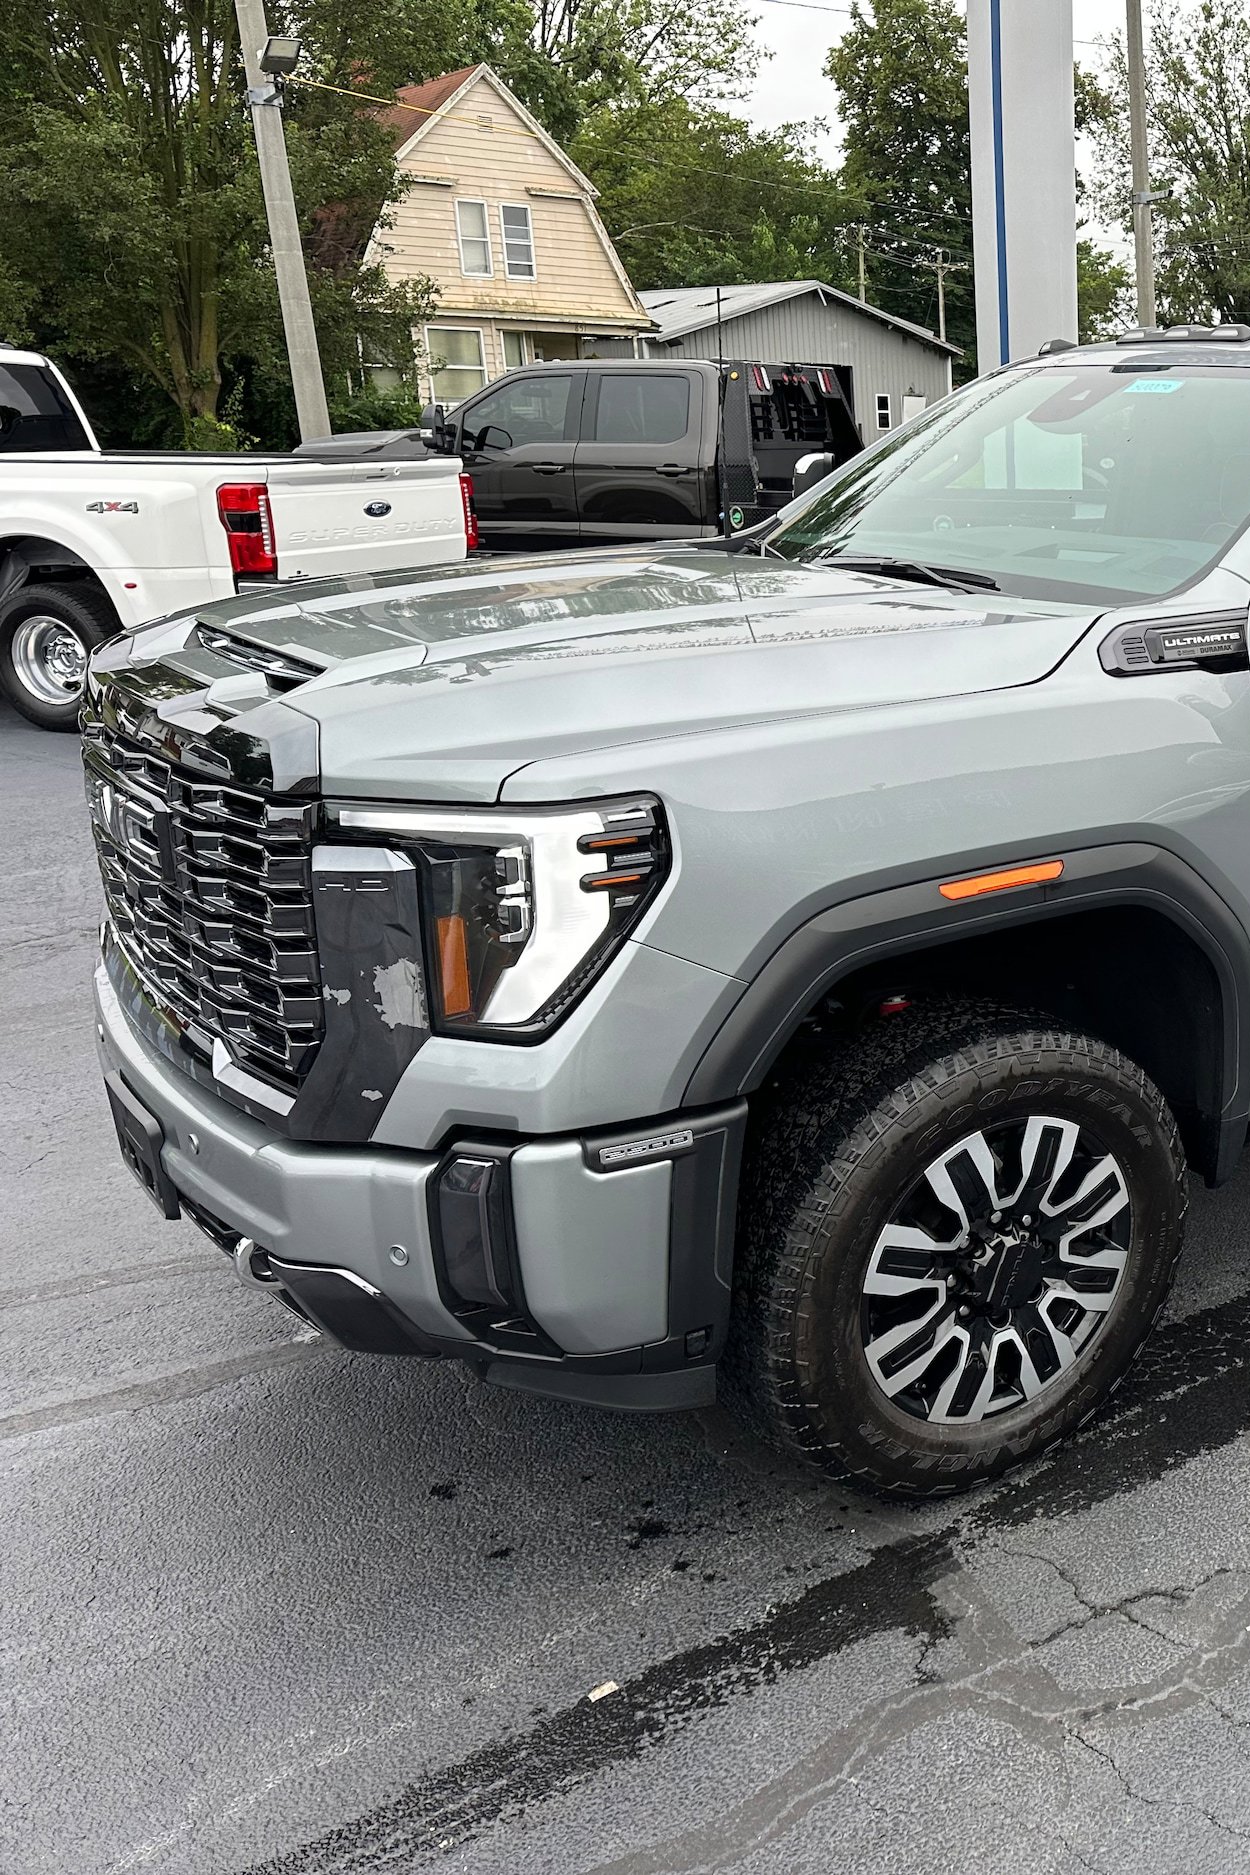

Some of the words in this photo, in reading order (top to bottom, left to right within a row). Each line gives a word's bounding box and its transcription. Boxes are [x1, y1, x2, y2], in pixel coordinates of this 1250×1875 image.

[288, 524, 390, 545] SUPER
[395, 517, 457, 534] DUTY
[1164, 632, 1241, 647] ULTIMATE
[1200, 644, 1233, 654] DURAMAX
[914, 1077, 1154, 1156] GOODYEAR
[604, 1135, 689, 1161] 2500
[857, 1384, 1099, 1472] WRANGLER
